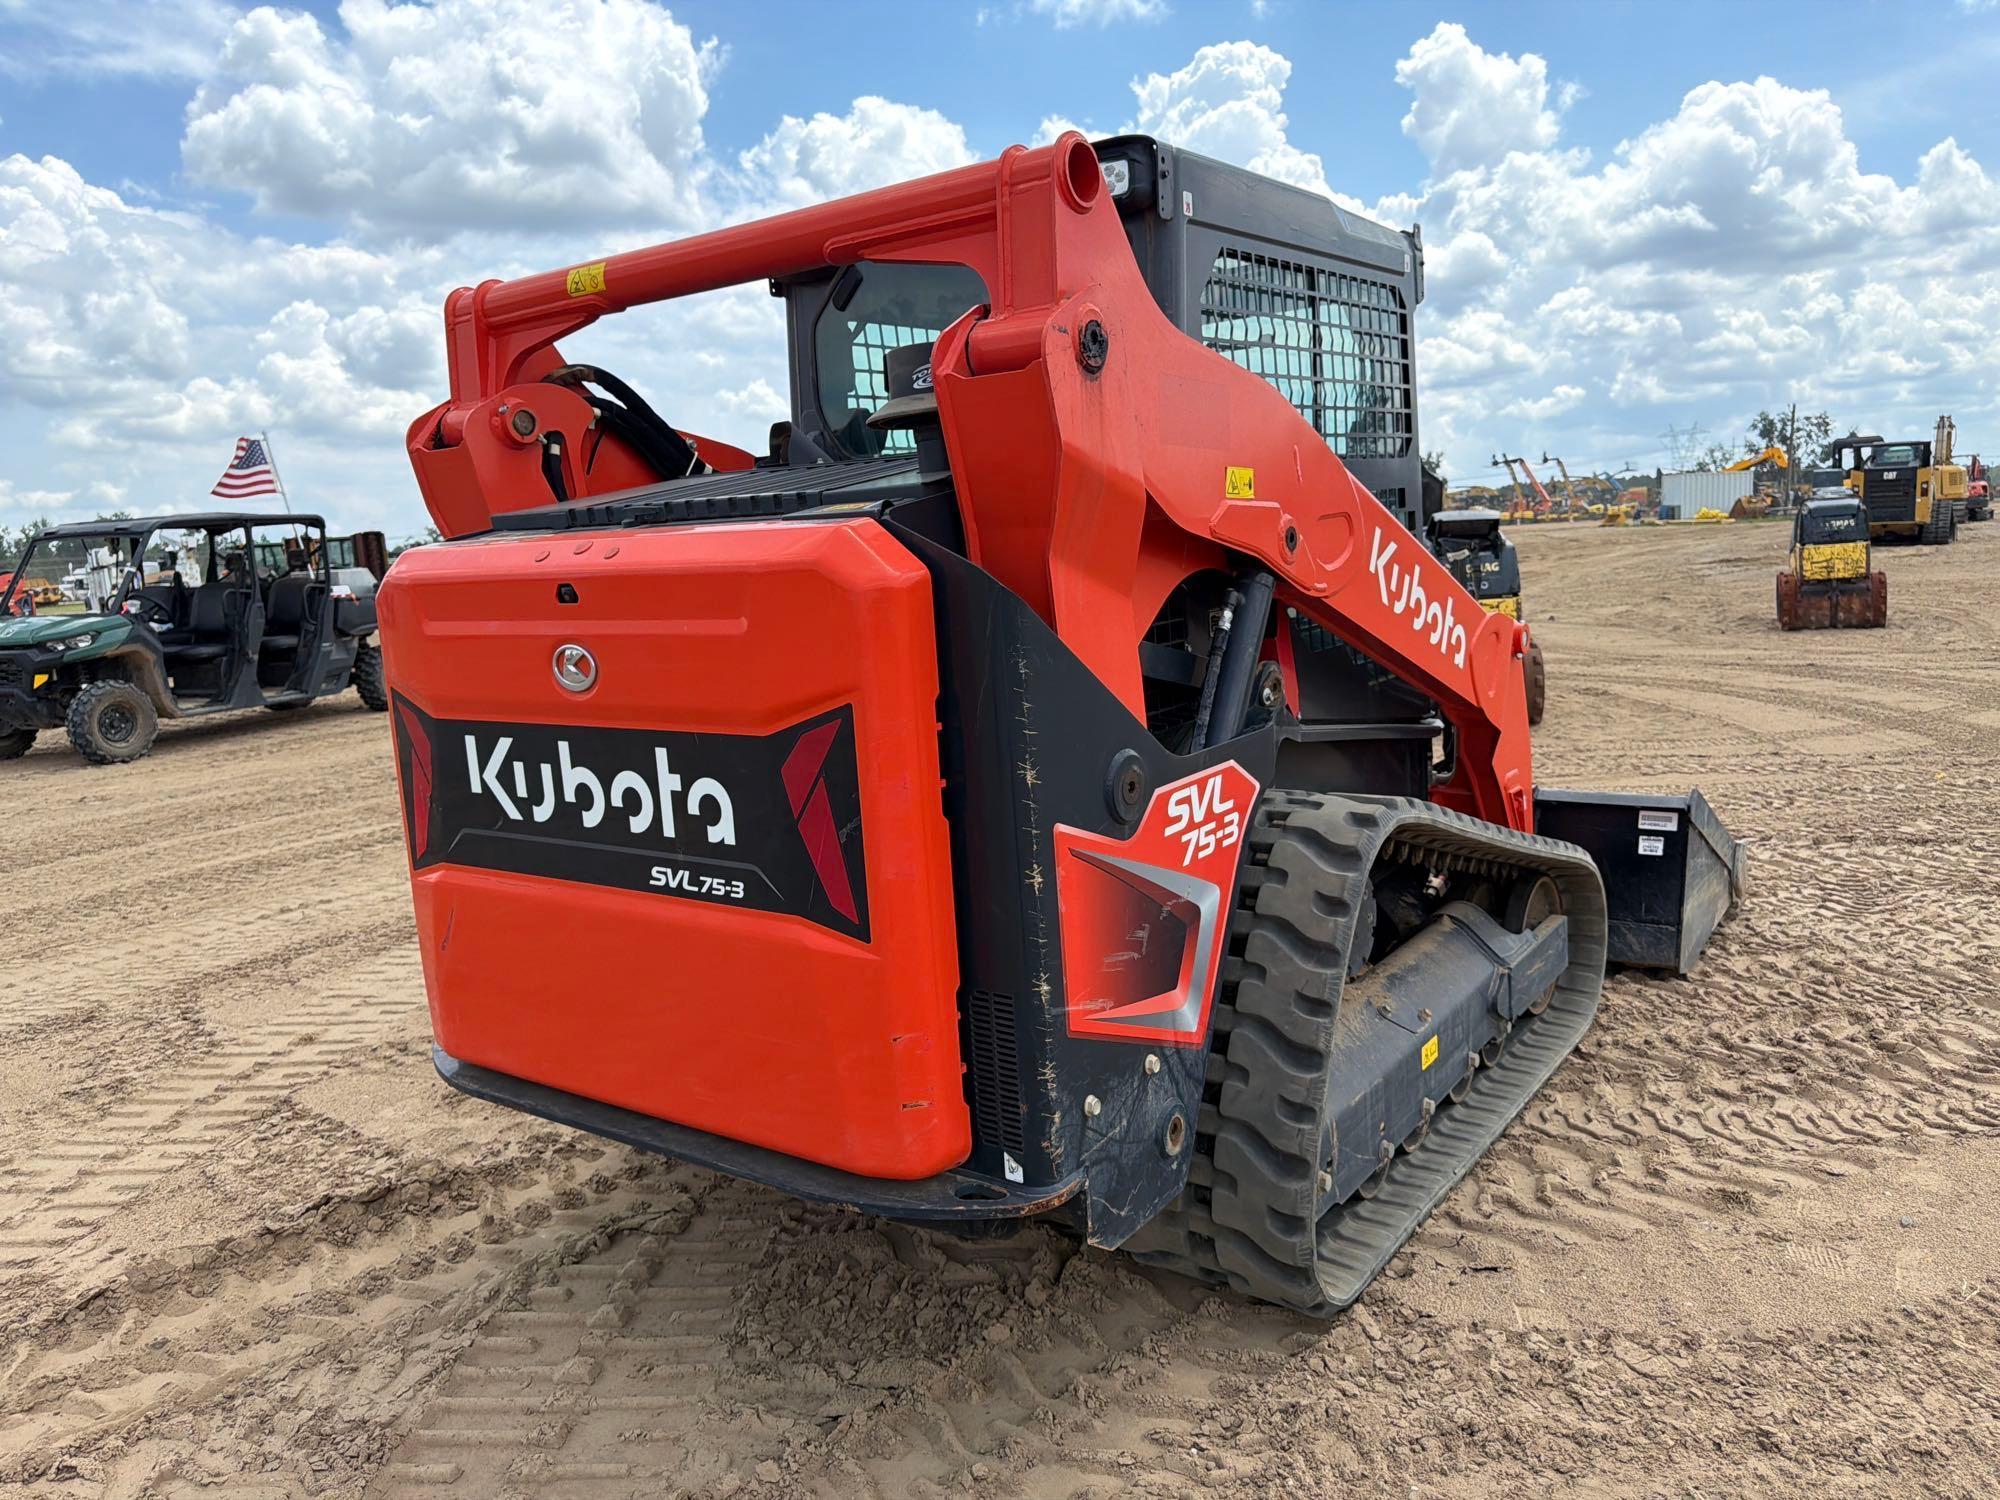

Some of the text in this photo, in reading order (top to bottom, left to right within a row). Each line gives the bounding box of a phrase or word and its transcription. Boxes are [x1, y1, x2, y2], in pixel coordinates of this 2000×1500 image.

[1883, 471, 1897, 480] CAT
[1369, 526, 1466, 669] Kubota
[464, 735, 736, 845] Kubota
[1164, 775, 1234, 837] SVL
[1181, 811, 1240, 867] 75-3
